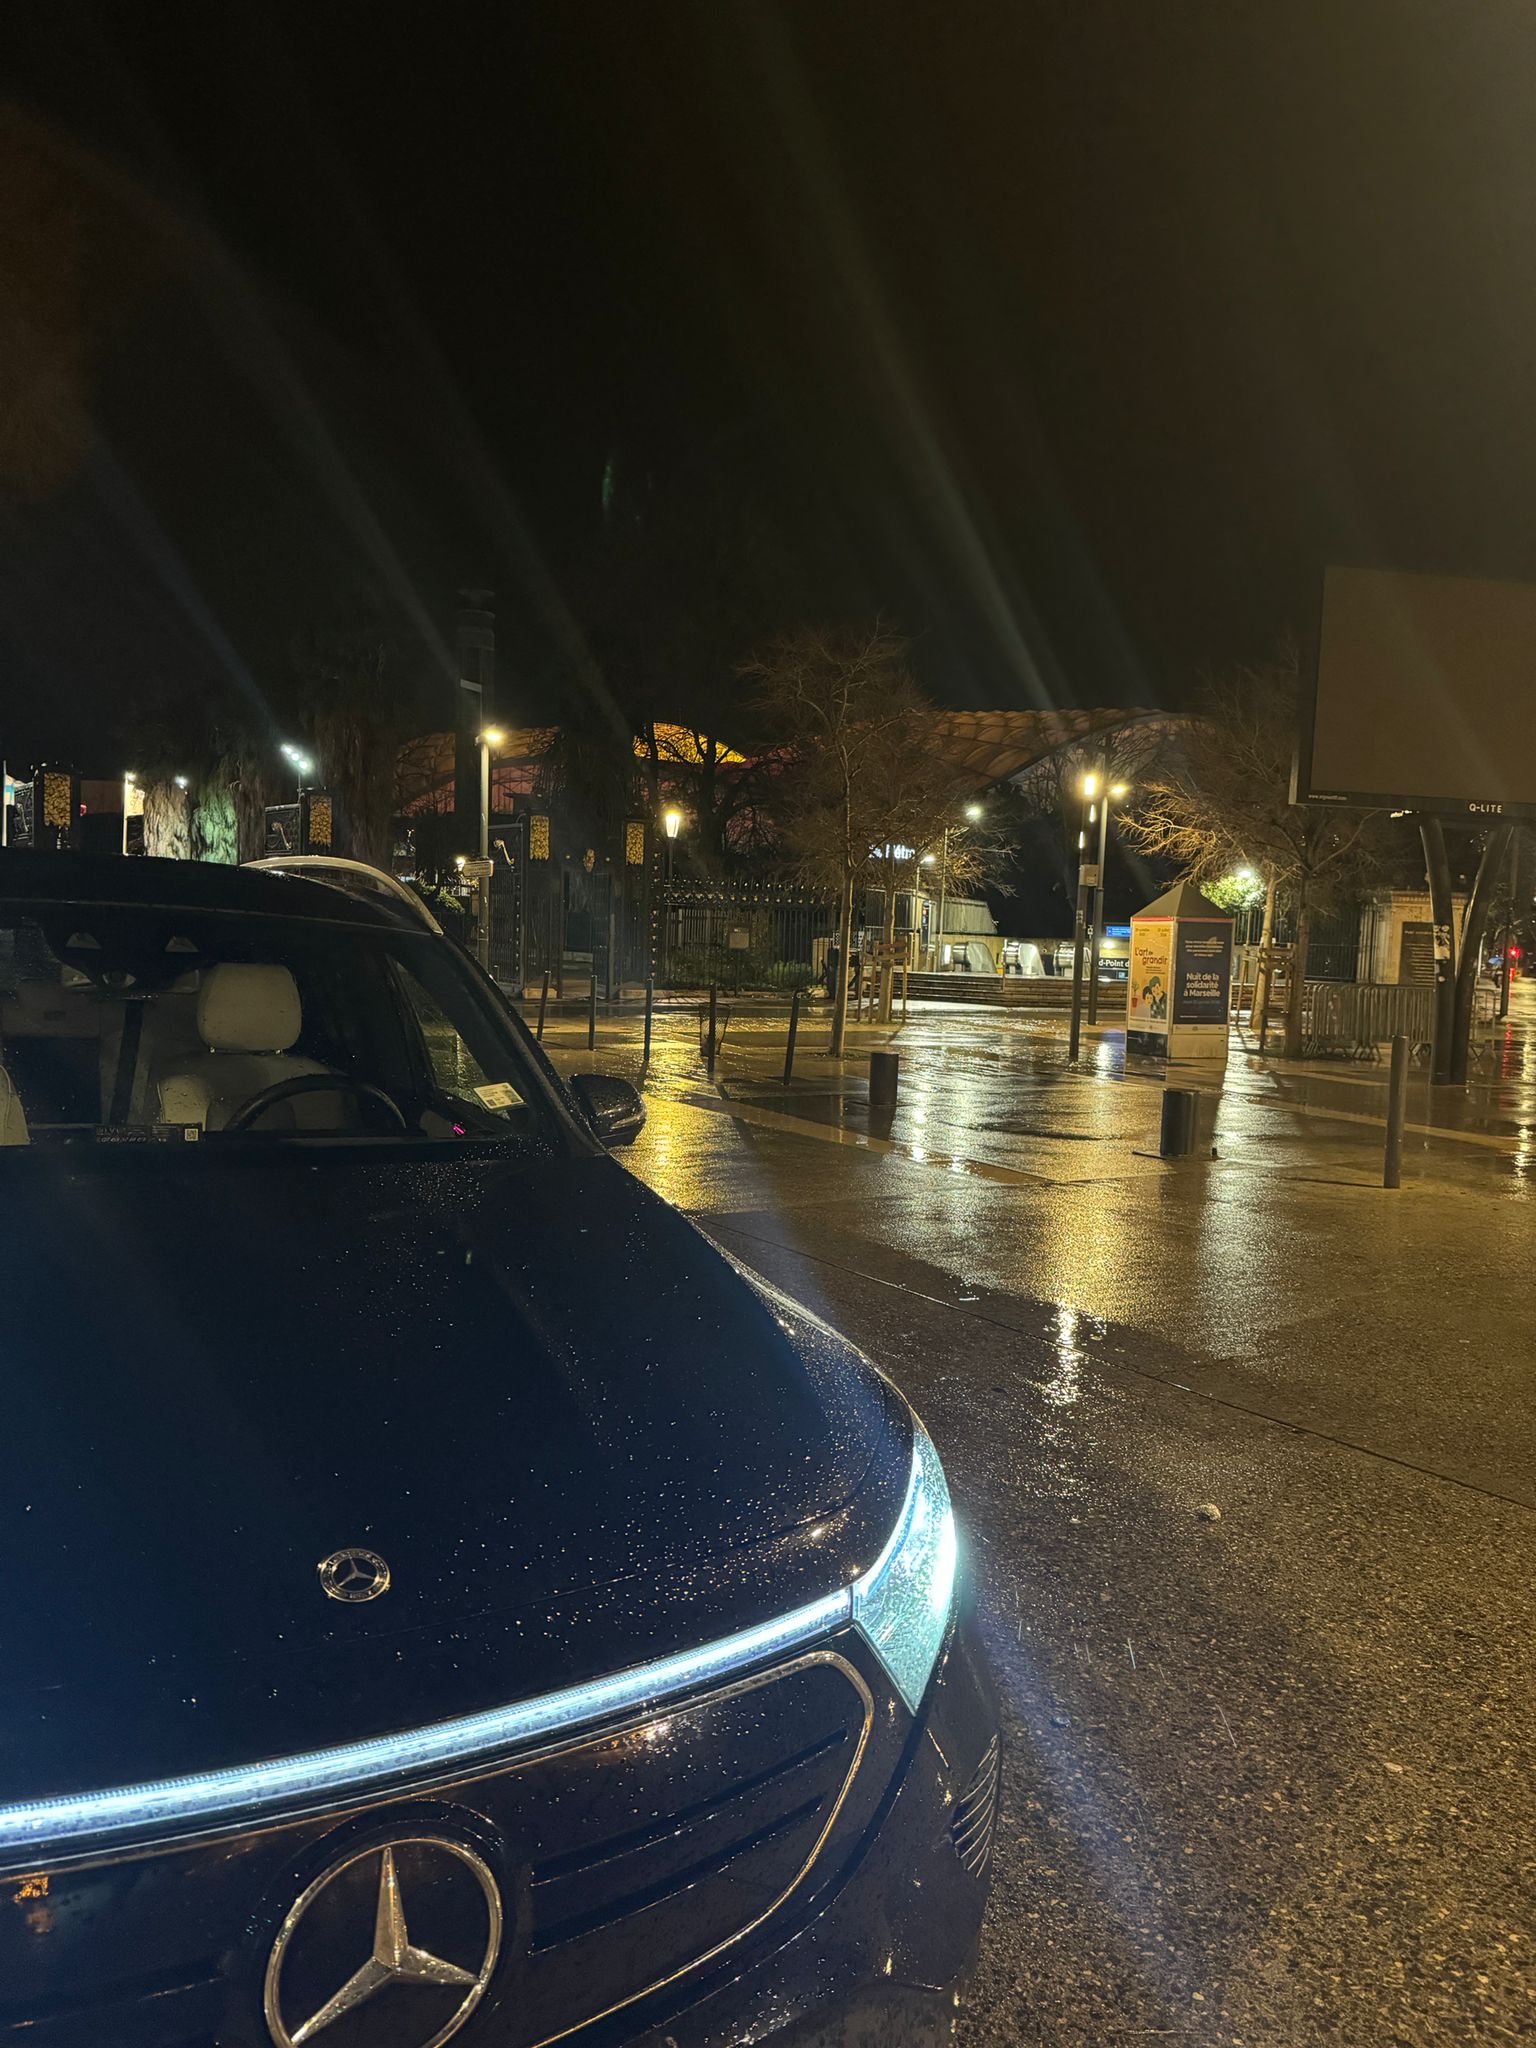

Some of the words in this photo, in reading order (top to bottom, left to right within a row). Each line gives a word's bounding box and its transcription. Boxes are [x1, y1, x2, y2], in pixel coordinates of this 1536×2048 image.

[1469, 803, 1502, 813] Q-LITE
[1098, 959, 1124, 968] d-Point
[1142, 955, 1168, 966] grandir
[1186, 972, 1202, 981] Nuit
[1202, 972, 1212, 981] de
[1212, 972, 1220, 981] la
[1186, 981, 1219, 989] solidarité
[1183, 988, 1189, 997] à
[1189, 988, 1221, 998] Marseille
